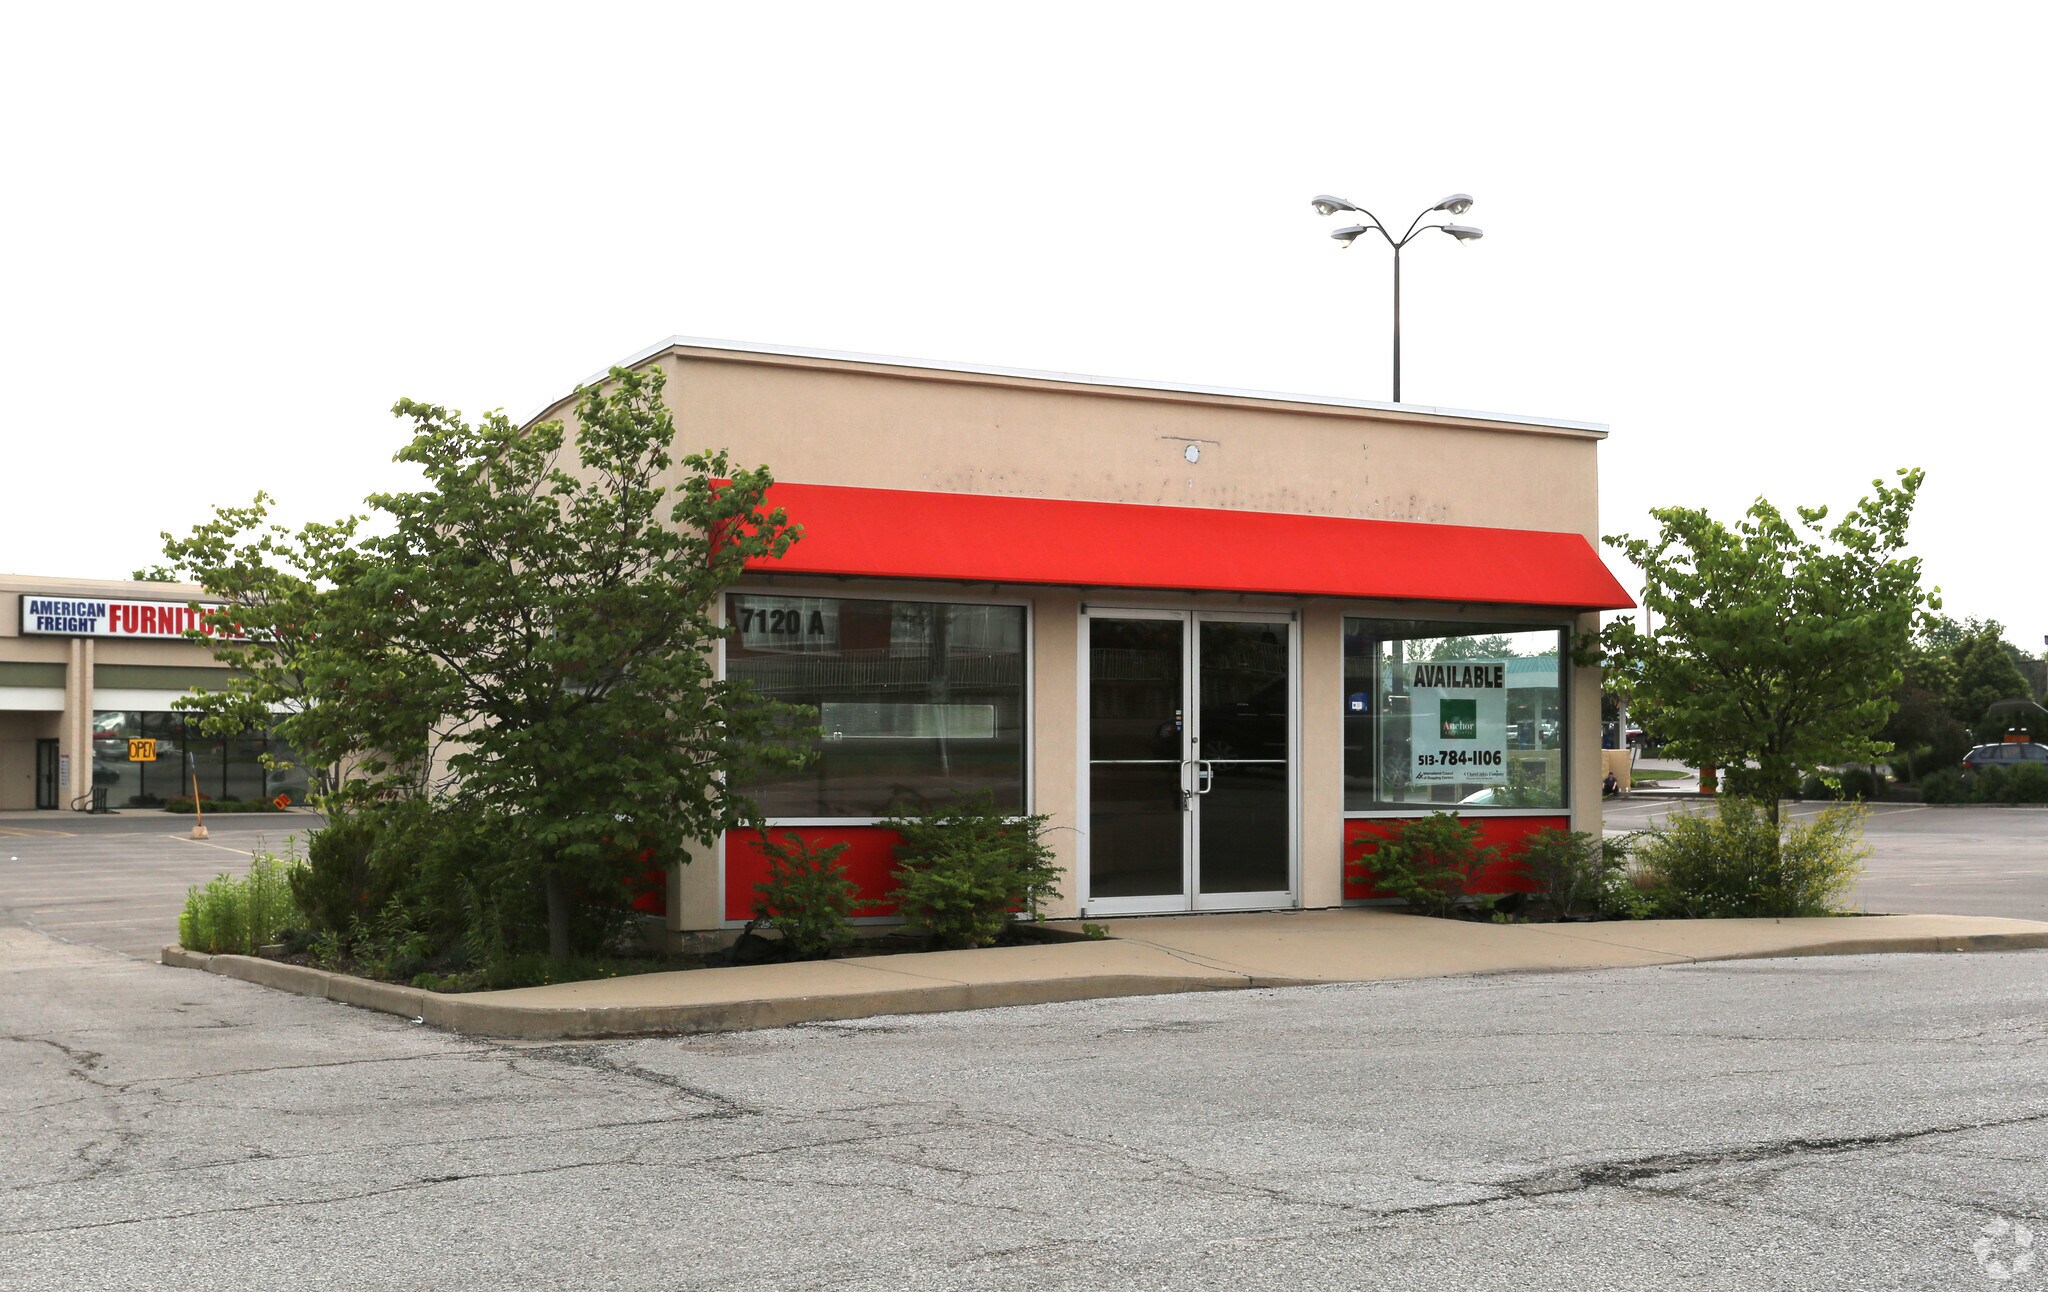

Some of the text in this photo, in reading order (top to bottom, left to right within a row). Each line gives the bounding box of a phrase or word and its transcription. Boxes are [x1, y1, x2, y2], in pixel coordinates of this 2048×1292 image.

[29, 600, 106, 618] AMERICAN
[37, 616, 97, 632] FREIGHT
[109, 604, 246, 638] FURNITU
[740, 609, 824, 635] 7120 A
[1413, 665, 1503, 688] AVAILABLE
[1443, 720, 1474, 730] Anchor
[130, 741, 156, 758] OPEN
[1418, 750, 1502, 766] 513-784-1106
